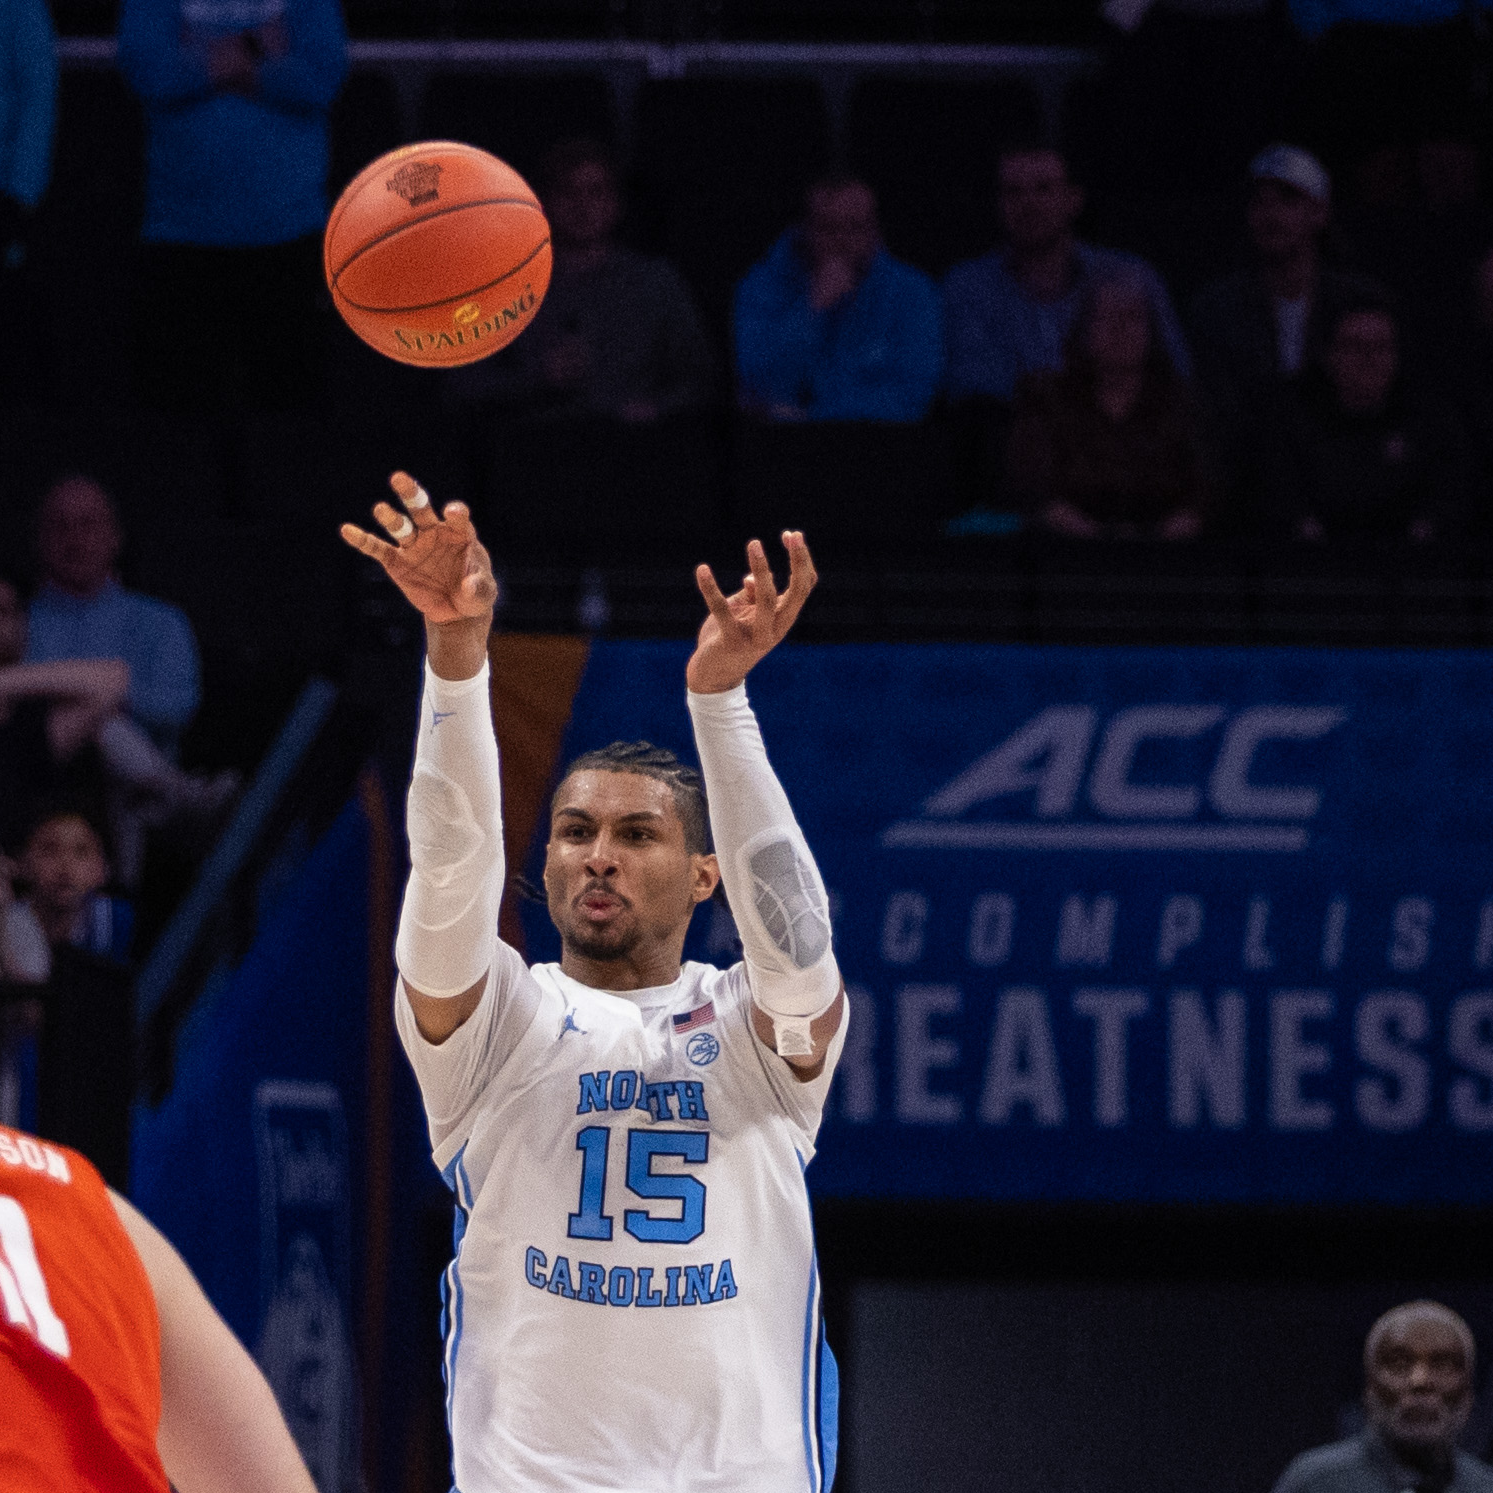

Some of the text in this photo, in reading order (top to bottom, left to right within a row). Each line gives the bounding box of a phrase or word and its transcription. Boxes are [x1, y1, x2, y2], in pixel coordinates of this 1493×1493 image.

[391, 282, 537, 352] SPALDING
[921, 703, 1349, 818] ACC
[567, 1126, 709, 1244] 15
[525, 1246, 738, 1307] CAROLINA
